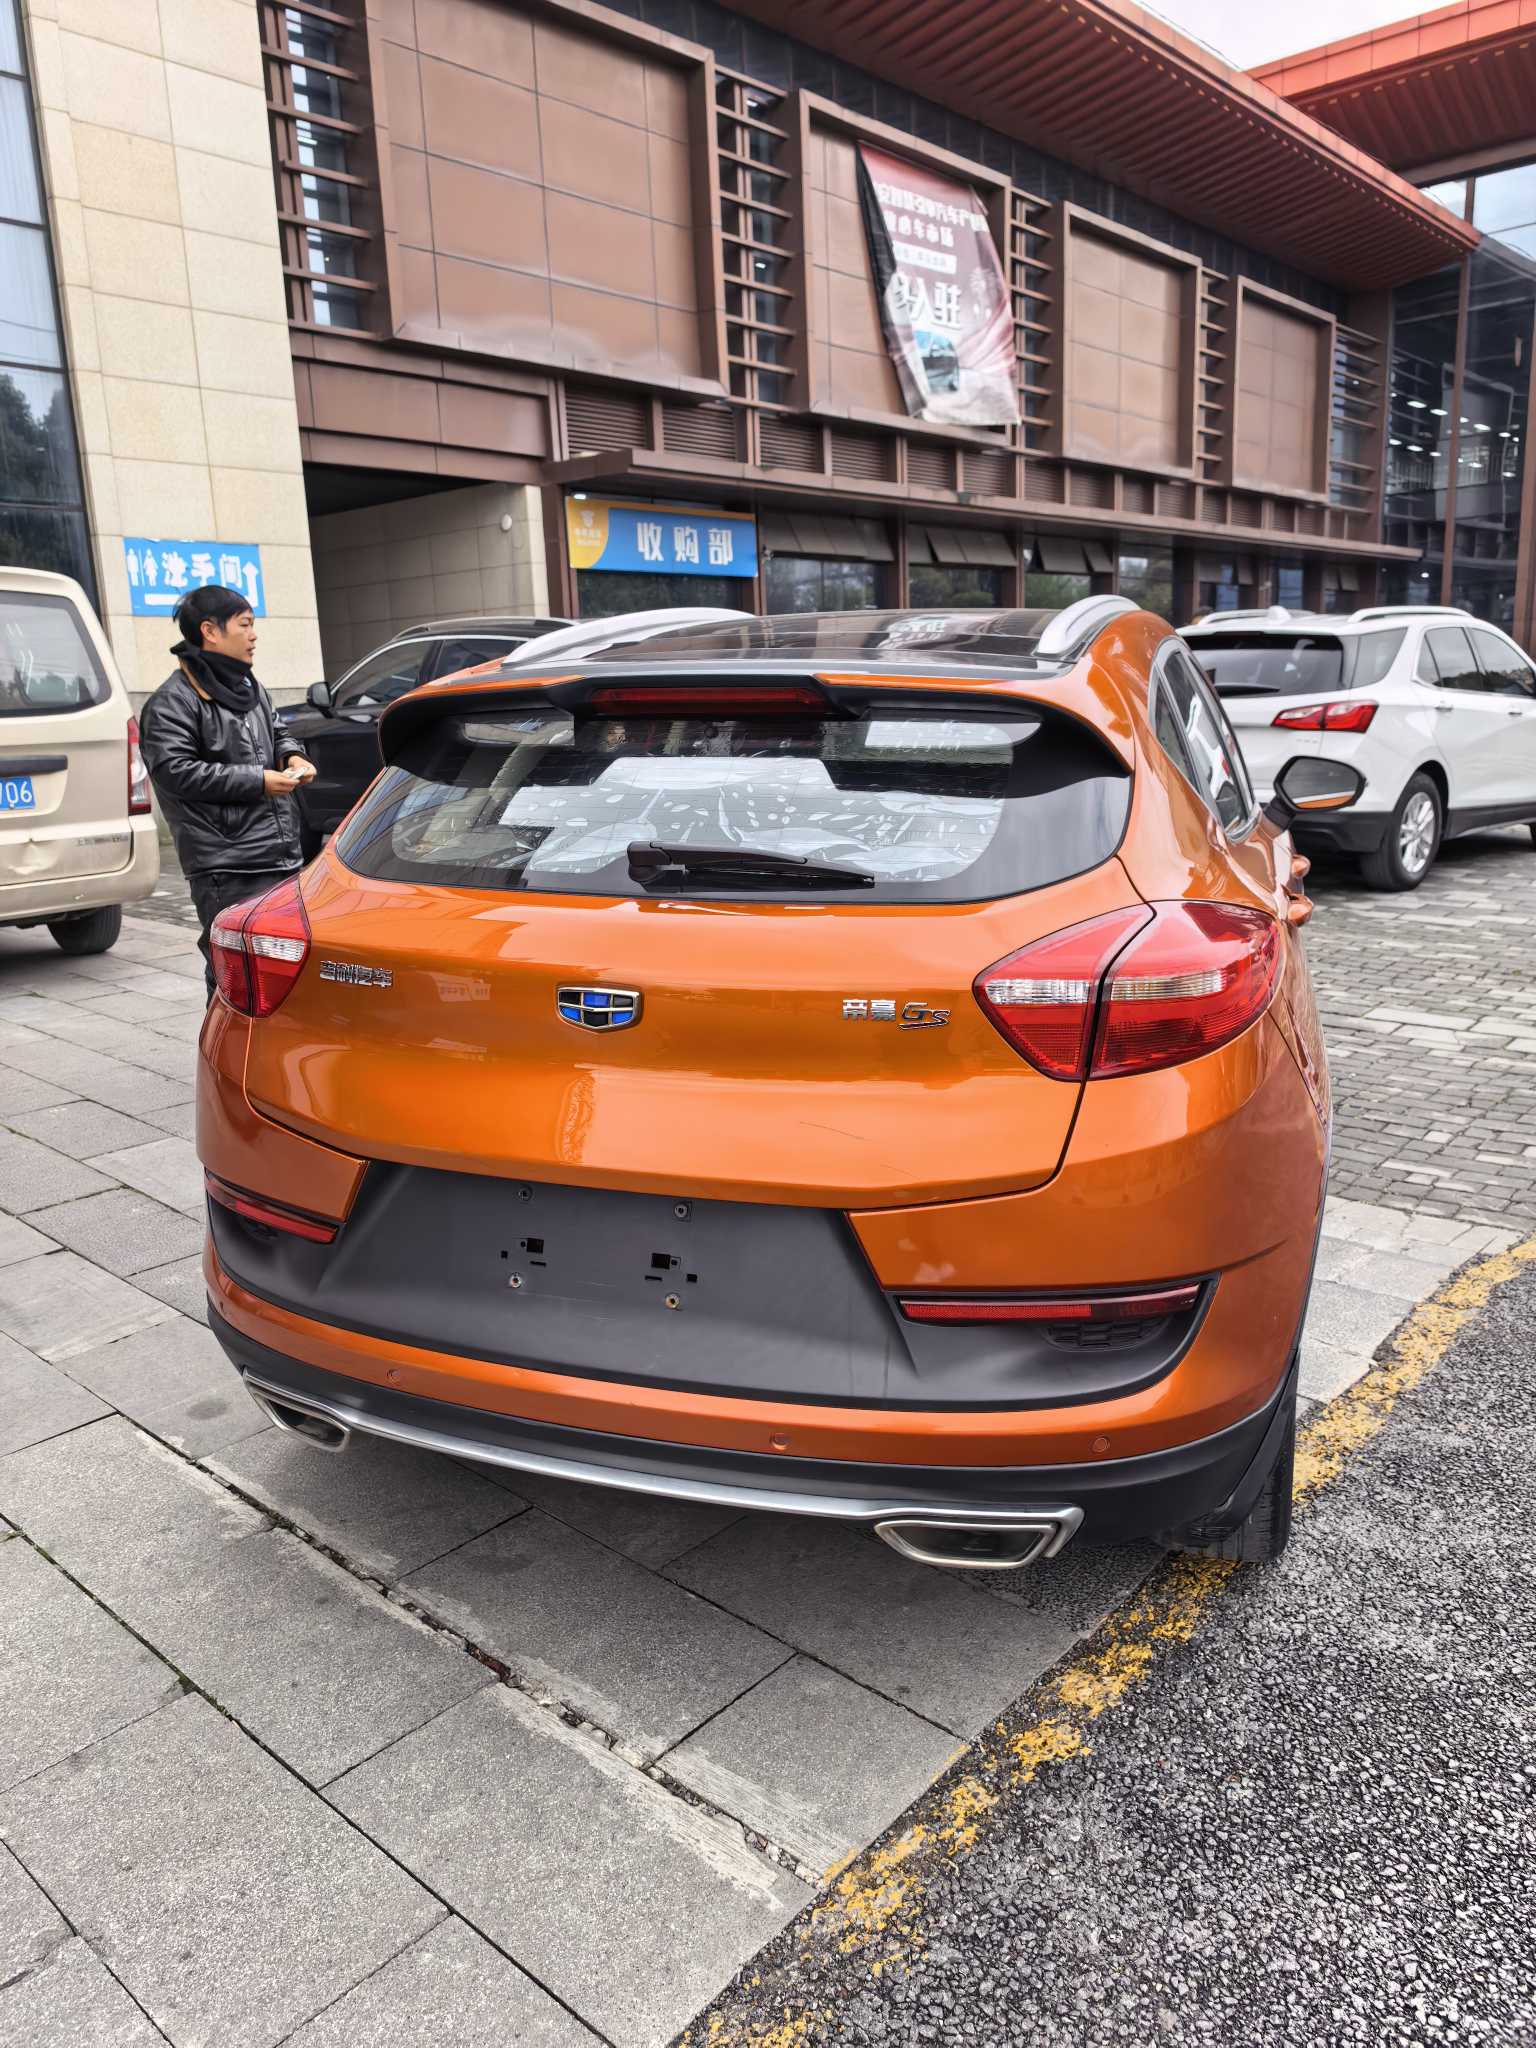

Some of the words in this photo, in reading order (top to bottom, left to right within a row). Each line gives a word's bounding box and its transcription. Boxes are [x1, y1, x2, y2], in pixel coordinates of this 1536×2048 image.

[637, 522, 734, 566] 收购部
[161, 551, 243, 589] 洗手间
[319, 960, 393, 988] 吉利汽车
[842, 999, 896, 1020] 帝豪
